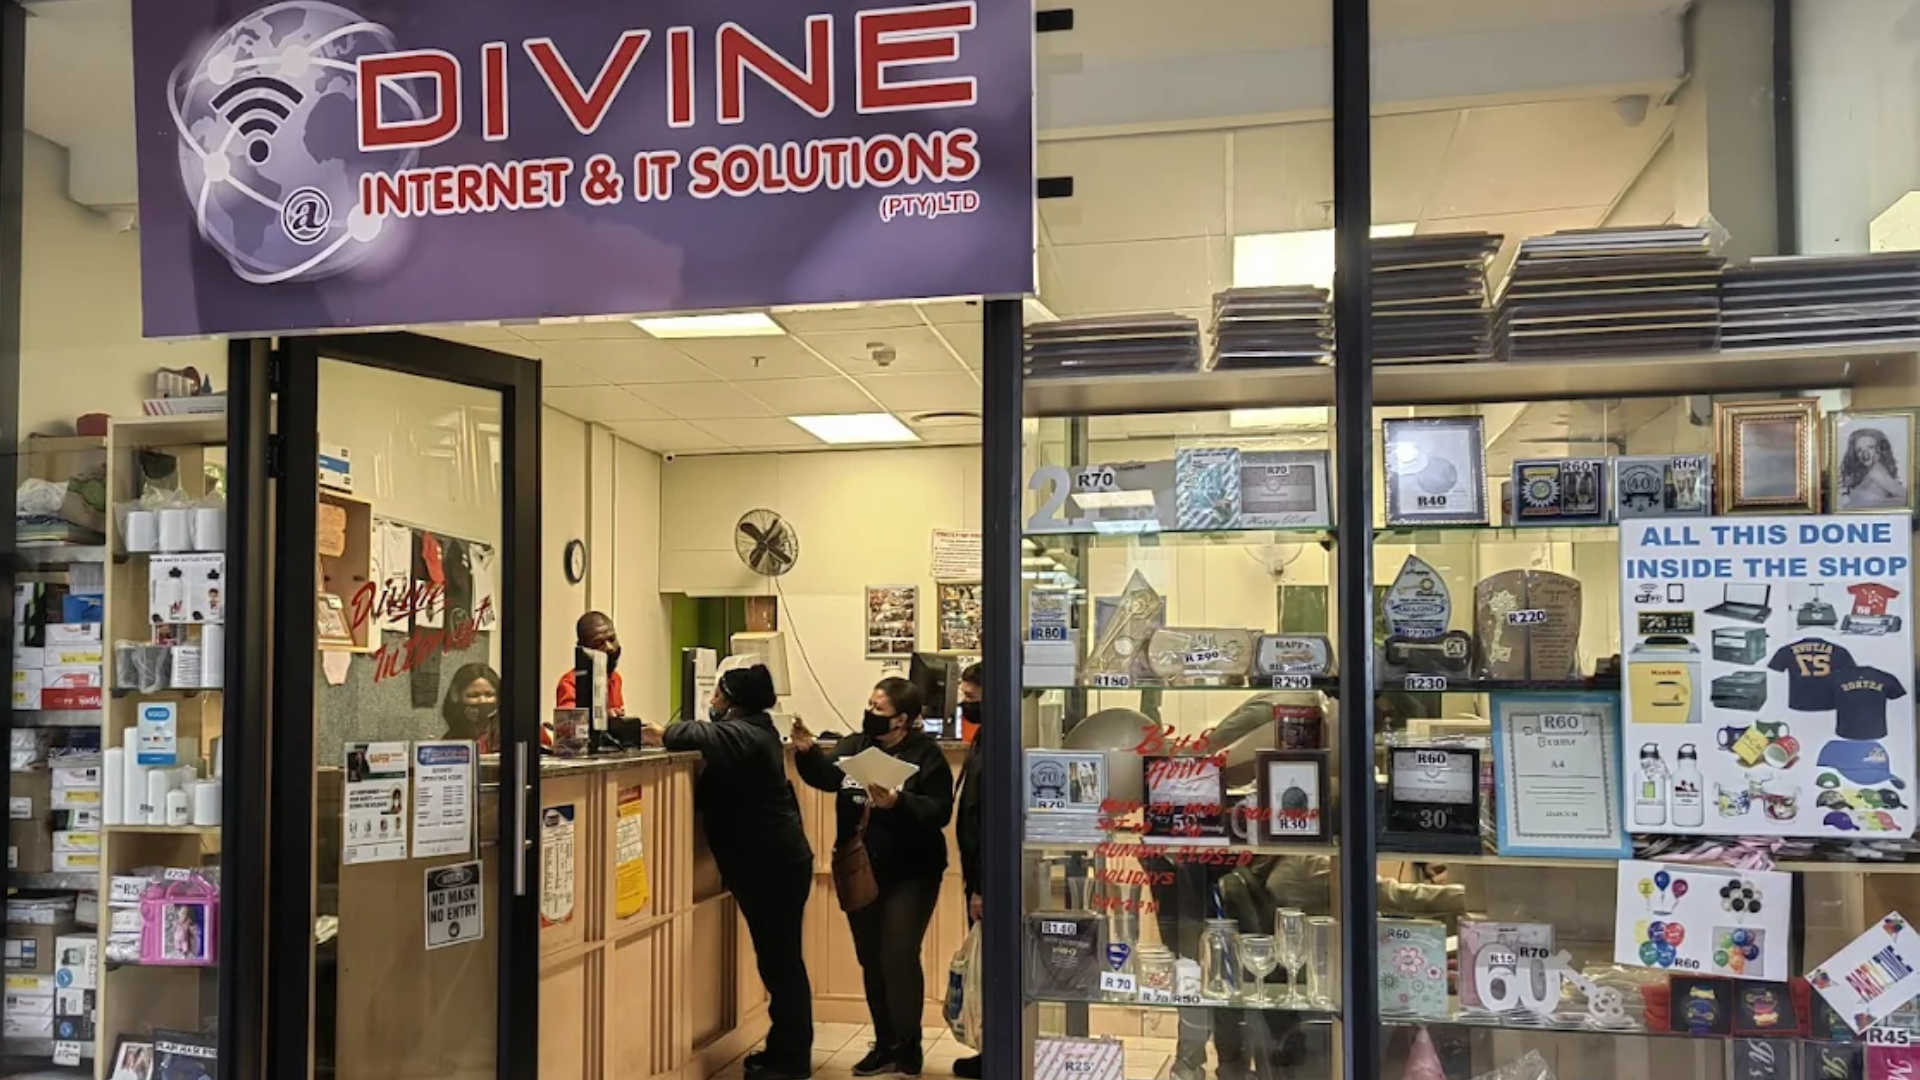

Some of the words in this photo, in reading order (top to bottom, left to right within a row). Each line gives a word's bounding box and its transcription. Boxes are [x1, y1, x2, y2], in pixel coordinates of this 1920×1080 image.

[357, 2, 978, 151] DIVINE
[360, 159, 571, 219] INTERNET
[586, 156, 620, 203] &
[634, 150, 679, 199] IT
[691, 131, 979, 196] SOLUTIONS
[880, 192, 981, 221] (PTY)LTD
[1267, 465, 1288, 475] R70
[1561, 461, 1590, 471] R60
[1673, 459, 1699, 469] R60
[1078, 473, 1113, 487] R70
[1418, 496, 1447, 507] R40
[1641, 526, 1700, 547] ALL
[1711, 525, 1788, 546] THIS
[1799, 523, 1892, 545] DONE
[1627, 558, 1732, 579] INSIDE
[1743, 558, 1807, 578] THE
[1818, 556, 1907, 577] SHOP
[1508, 611, 1546, 623] R220
[1037, 628, 1060, 638] R80
[1274, 675, 1309, 688] R240
[1407, 678, 1444, 689] R230
[1544, 716, 1579, 729] R60
[1418, 753, 1446, 763] R60
[1550, 761, 1565, 769] A4
[1040, 771, 1057, 783] 70
[1037, 800, 1065, 809] R70
[1280, 819, 1307, 829] R30
[1176, 845, 1253, 866] CLOSED
[1095, 868, 1175, 885] HOLIDAYS
[124, 883, 139, 895] R5
[432, 893, 445, 906] NO
[448, 888, 476, 904] MASK
[430, 908, 444, 923] NO
[447, 903, 477, 920] ENTRY
[1043, 923, 1076, 934] R140
[1388, 929, 1411, 939] R60
[1520, 946, 1549, 958] R70
[1491, 954, 1515, 963] R15
[1674, 958, 1700, 969] R60
[1105, 977, 1115, 988] R
[1117, 979, 1131, 990] 70
[1474, 942, 1561, 1014] 60
[1143, 993, 1151, 1002] R
[1174, 995, 1201, 1004] R50
[1868, 1028, 1909, 1045] R45
[1065, 1061, 1092, 1072] R25
